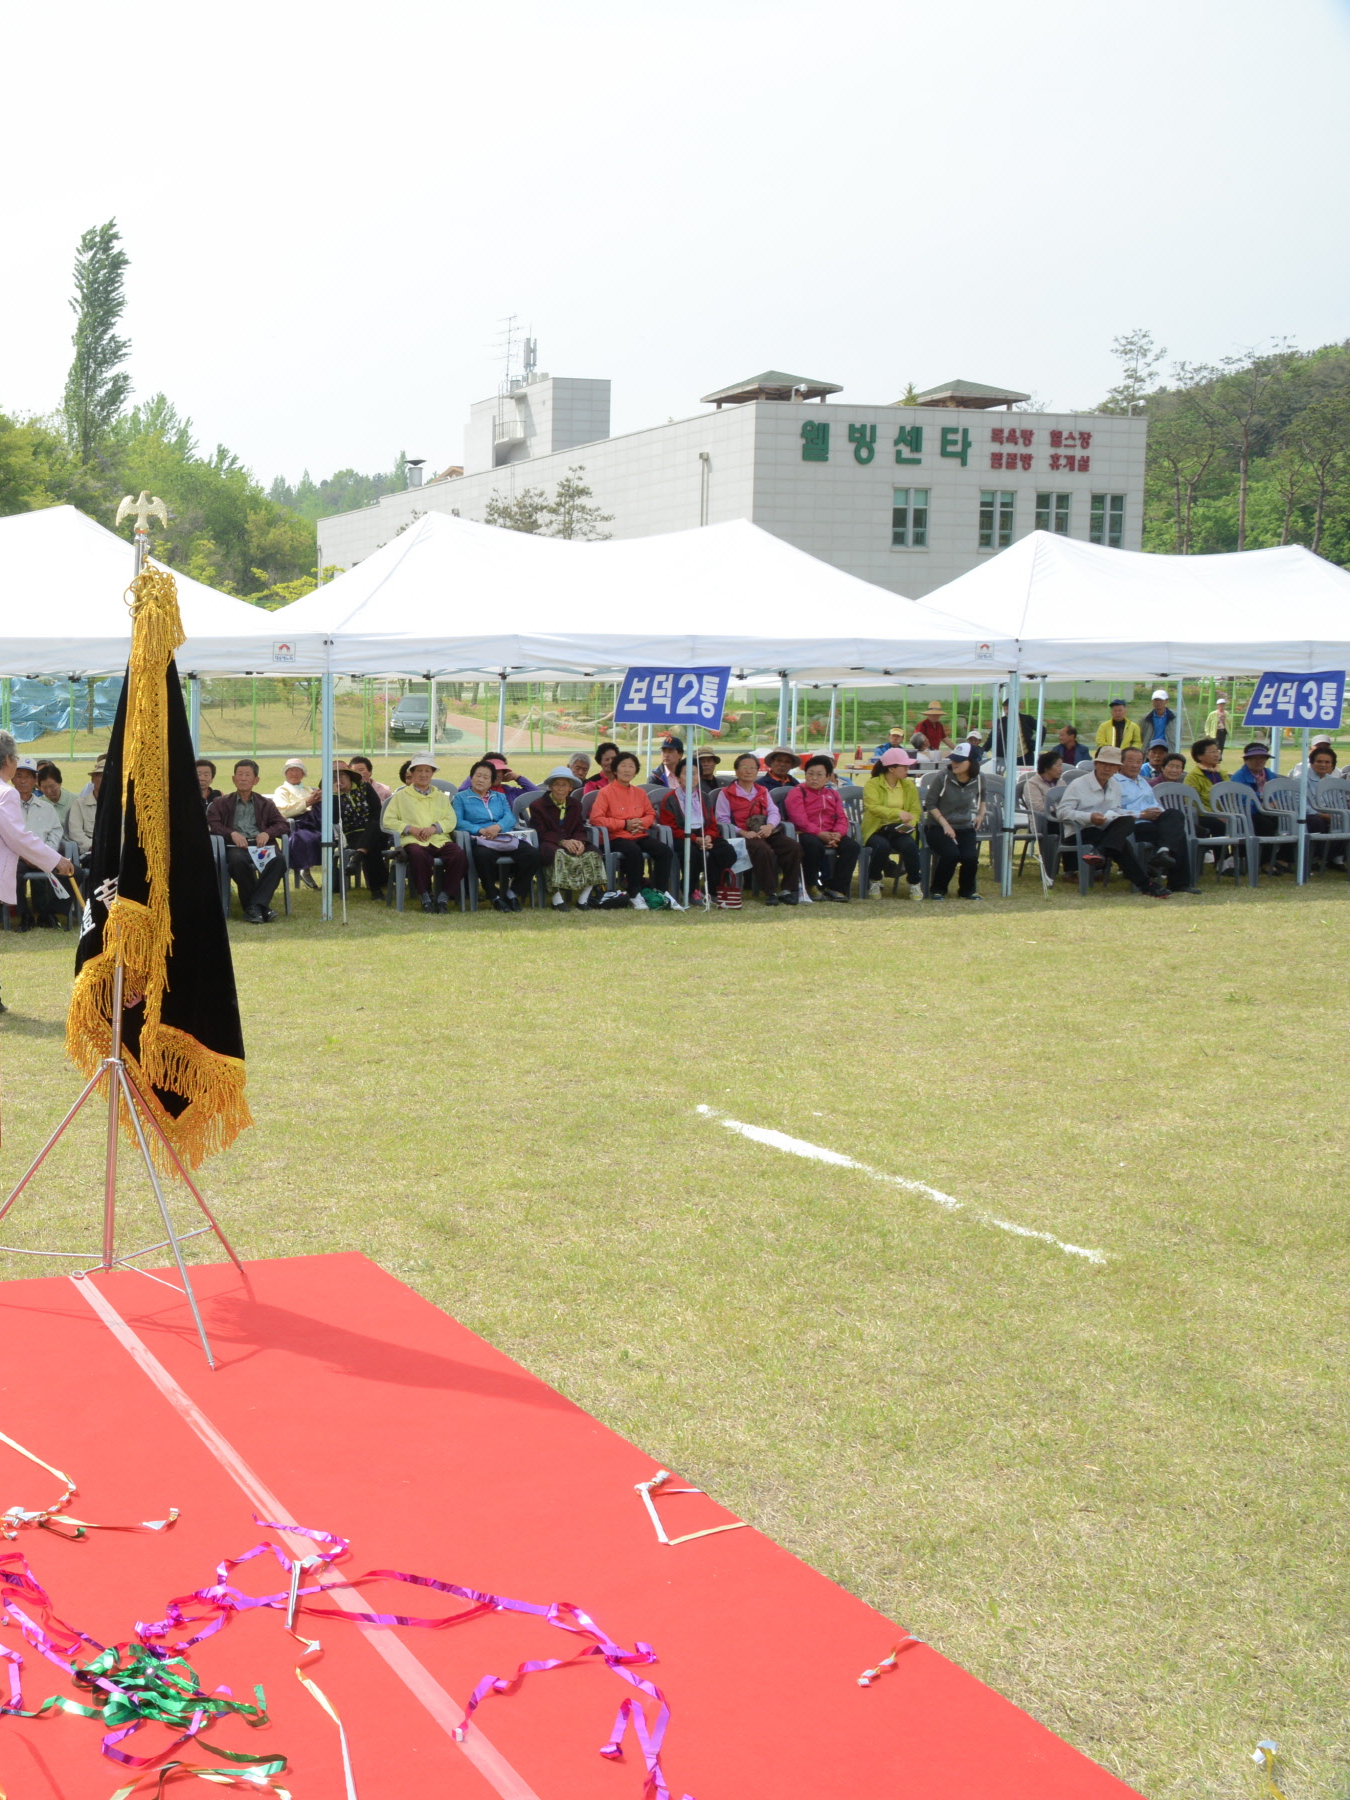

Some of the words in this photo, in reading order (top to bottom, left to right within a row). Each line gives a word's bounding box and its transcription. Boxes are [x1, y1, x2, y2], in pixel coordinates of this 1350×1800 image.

[801, 420, 972, 467] 웰빙센타
[991, 428, 1034, 447] 목욕탕
[1050, 430, 1092, 449] 헬스장
[990, 452, 1033, 471] 찜질방
[1049, 453, 1090, 472] 휴게실
[623, 673, 720, 719] 보덕2통
[1252, 680, 1338, 721] 보덕3통
